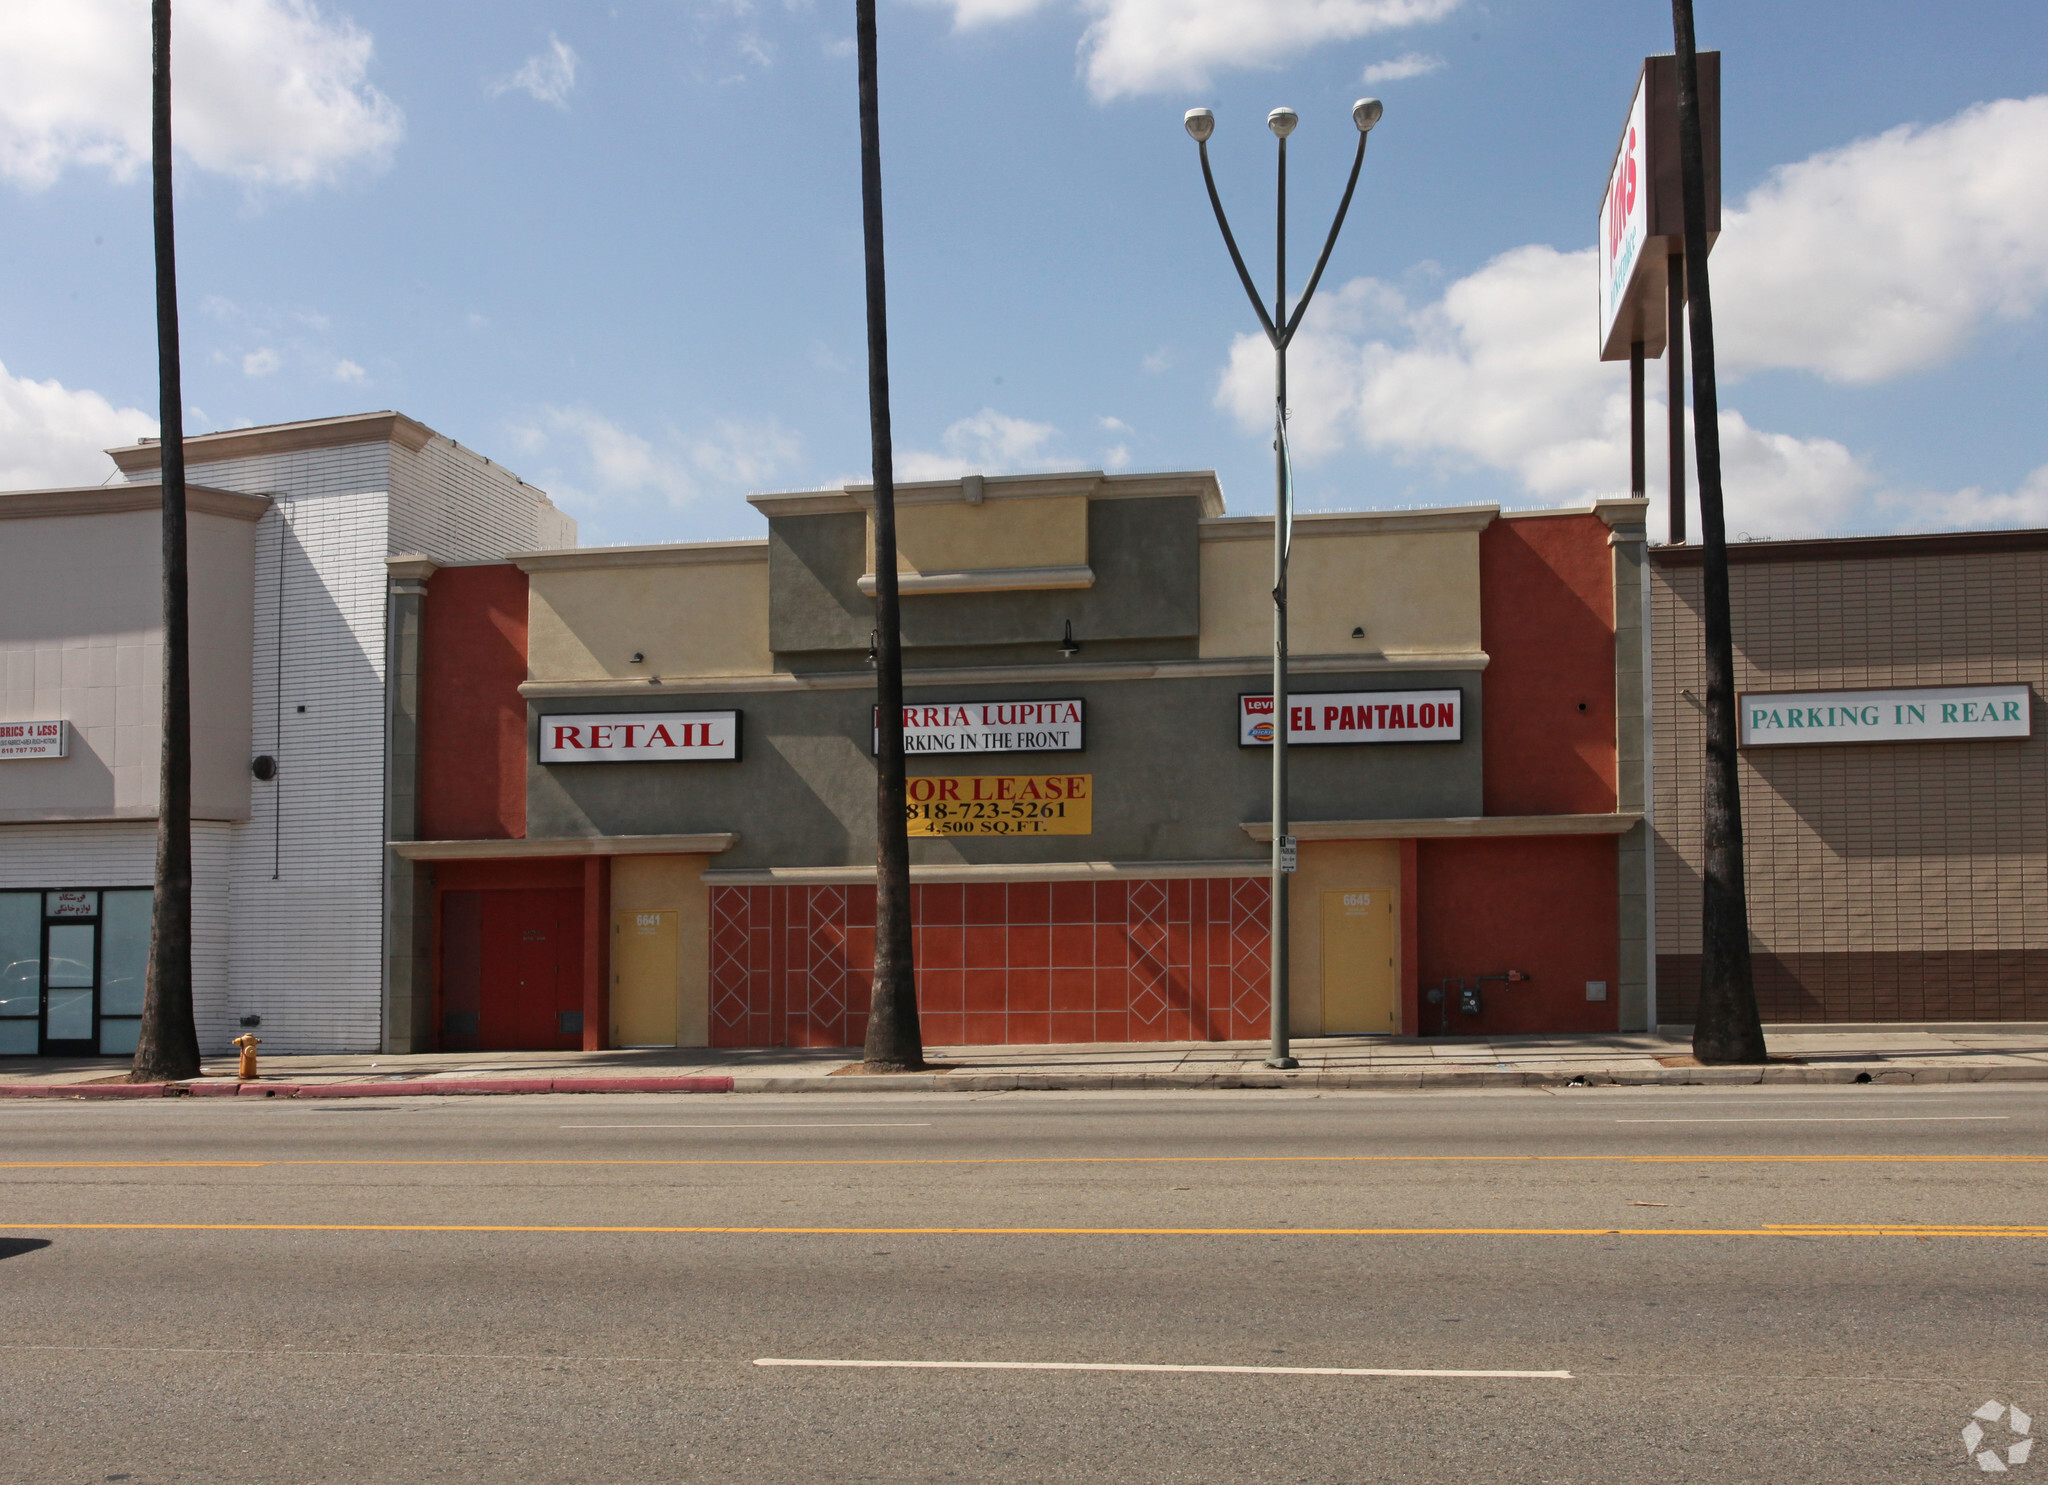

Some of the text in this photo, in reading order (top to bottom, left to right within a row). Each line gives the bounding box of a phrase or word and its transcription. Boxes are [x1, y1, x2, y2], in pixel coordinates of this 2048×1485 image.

[982, 703, 1081, 725] LUPITA
[1290, 703, 1454, 731] EL PANTALON
[1751, 701, 2021, 729] PARKING IN REAR
[0, 725, 58, 738] BRICS 4 LESS
[552, 722, 725, 750] RETAIL
[905, 731, 1070, 751] RKING IN THE FRONT
[905, 776, 1087, 802] OR LEASE
[906, 802, 1067, 820] 818-723-5261
[925, 820, 1048, 835] 4,500 SQ.FT.
[1343, 894, 1370, 906] 6645
[636, 914, 661, 926] 6641
